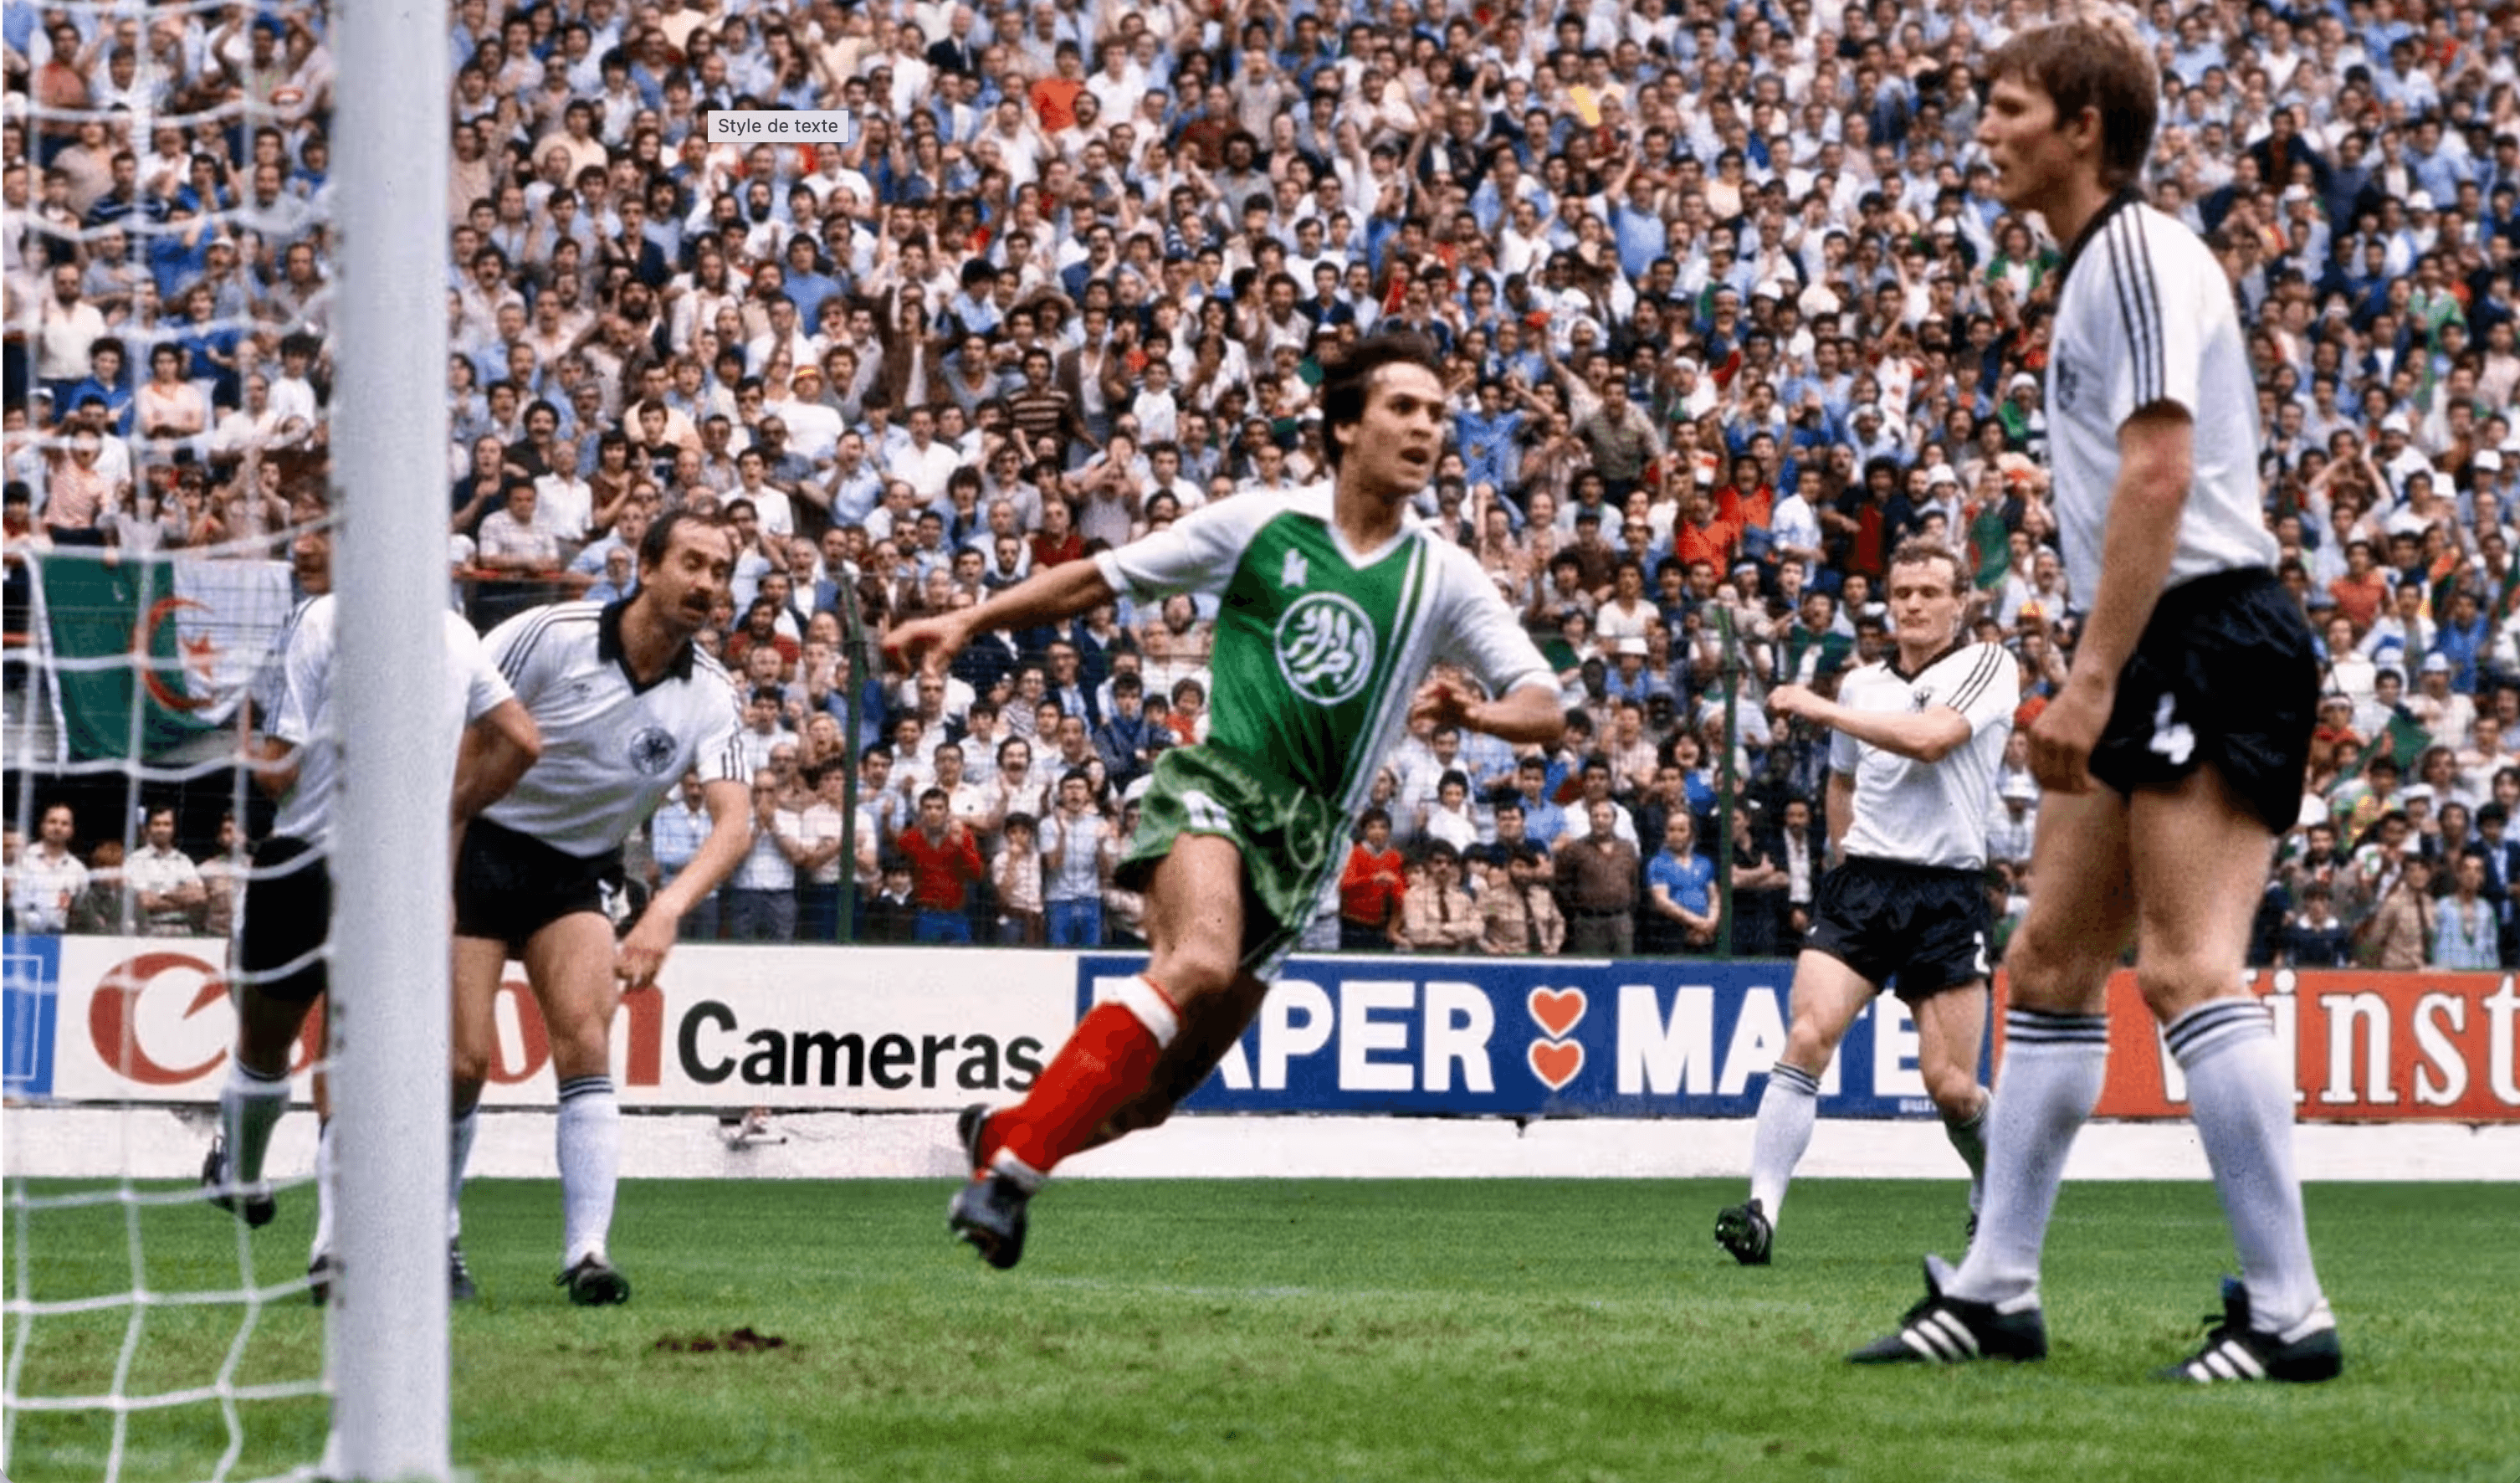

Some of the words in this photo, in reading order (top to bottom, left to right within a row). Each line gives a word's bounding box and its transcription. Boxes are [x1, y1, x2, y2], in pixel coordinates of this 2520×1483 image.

[2149, 691, 2195, 765] 4
[677, 1000, 1045, 1093] Cameras
[1094, 977, 1494, 1092] PER
[1617, 985, 1928, 1096] MAE
[2157, 969, 2520, 1106] inst
